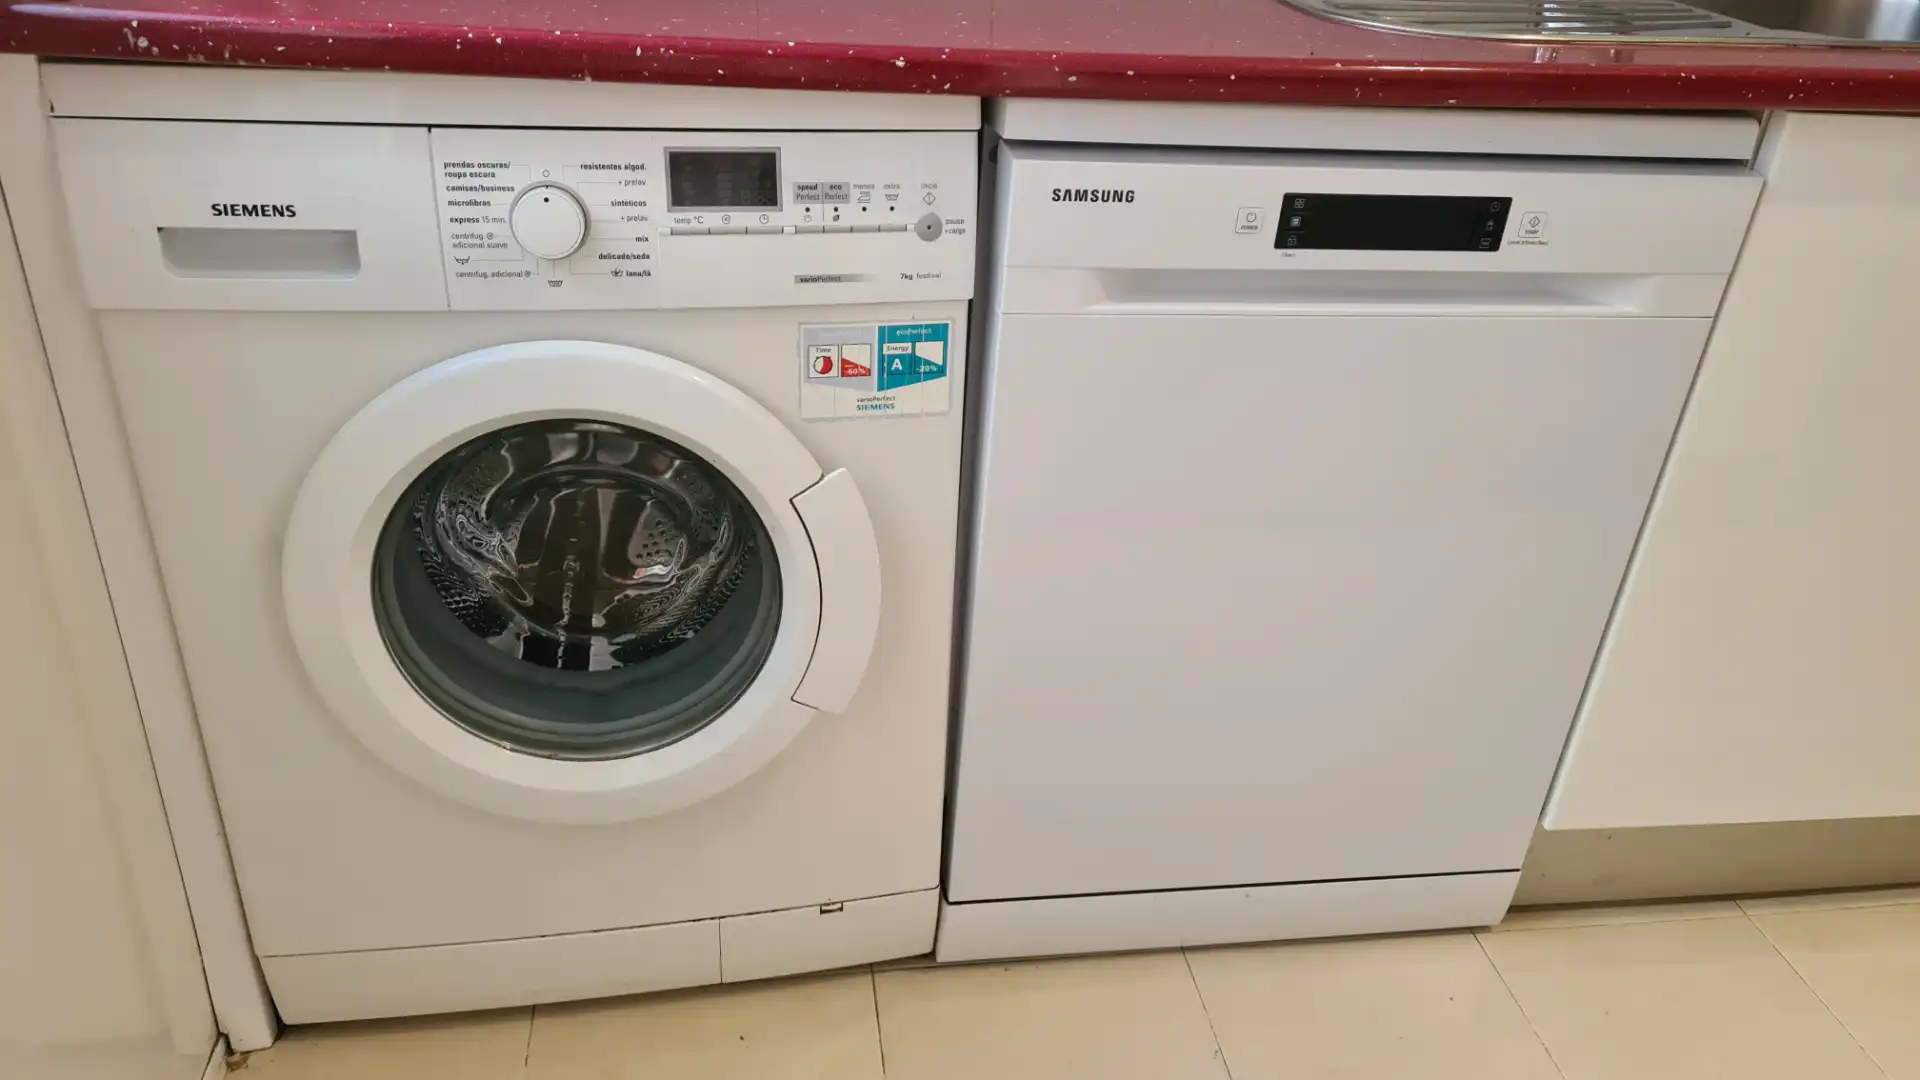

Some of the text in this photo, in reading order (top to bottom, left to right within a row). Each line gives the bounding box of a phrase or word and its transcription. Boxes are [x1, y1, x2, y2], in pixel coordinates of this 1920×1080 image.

[443, 161, 511, 170] prendas oscuras/
[580, 162, 647, 172] resistentes algod.
[444, 170, 467, 179] roupa
[446, 183, 515, 193] camisas/business
[797, 183, 818, 191] speed
[824, 192, 848, 201] Perfect
[1051, 188, 1136, 204] SAMSUNG
[447, 198, 491, 207] microfibras
[610, 198, 647, 207] sintéticos
[211, 203, 297, 218] SIEMENS
[449, 215, 507, 225] express 15 min.
[451, 232, 486, 241] centrifug.
[452, 241, 486, 249] adicional
[598, 252, 651, 261] delicado/seda
[490, 270, 523, 278] adicional
[900, 272, 913, 281] 7kg
[799, 275, 842, 284] varioPerfect
[890, 358, 903, 371] A
[856, 395, 896, 403] varioPerfect
[856, 403, 896, 411] SIEMENS
